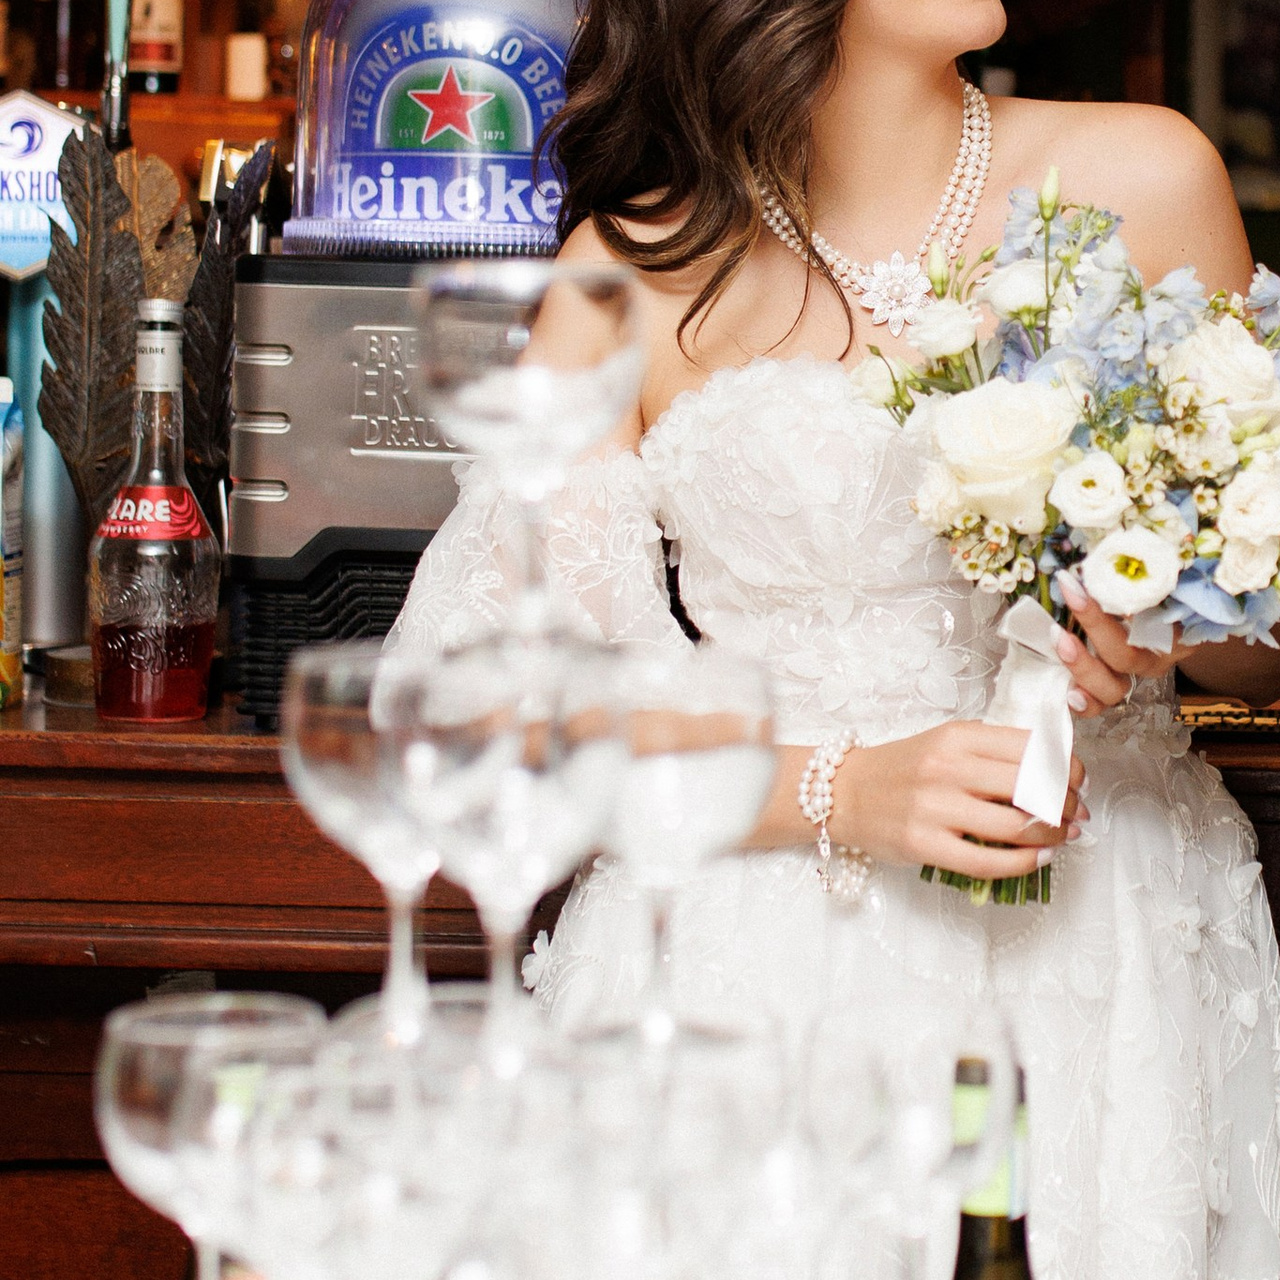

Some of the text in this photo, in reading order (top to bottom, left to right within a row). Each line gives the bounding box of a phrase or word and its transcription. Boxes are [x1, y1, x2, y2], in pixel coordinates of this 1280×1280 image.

[351, 21, 466, 130] HEINEKEN
[521, 57, 567, 121] BEE
[483, 130, 505, 141] 1873
[332, 161, 564, 224] Heineke
[107, 498, 171, 522] LARE
